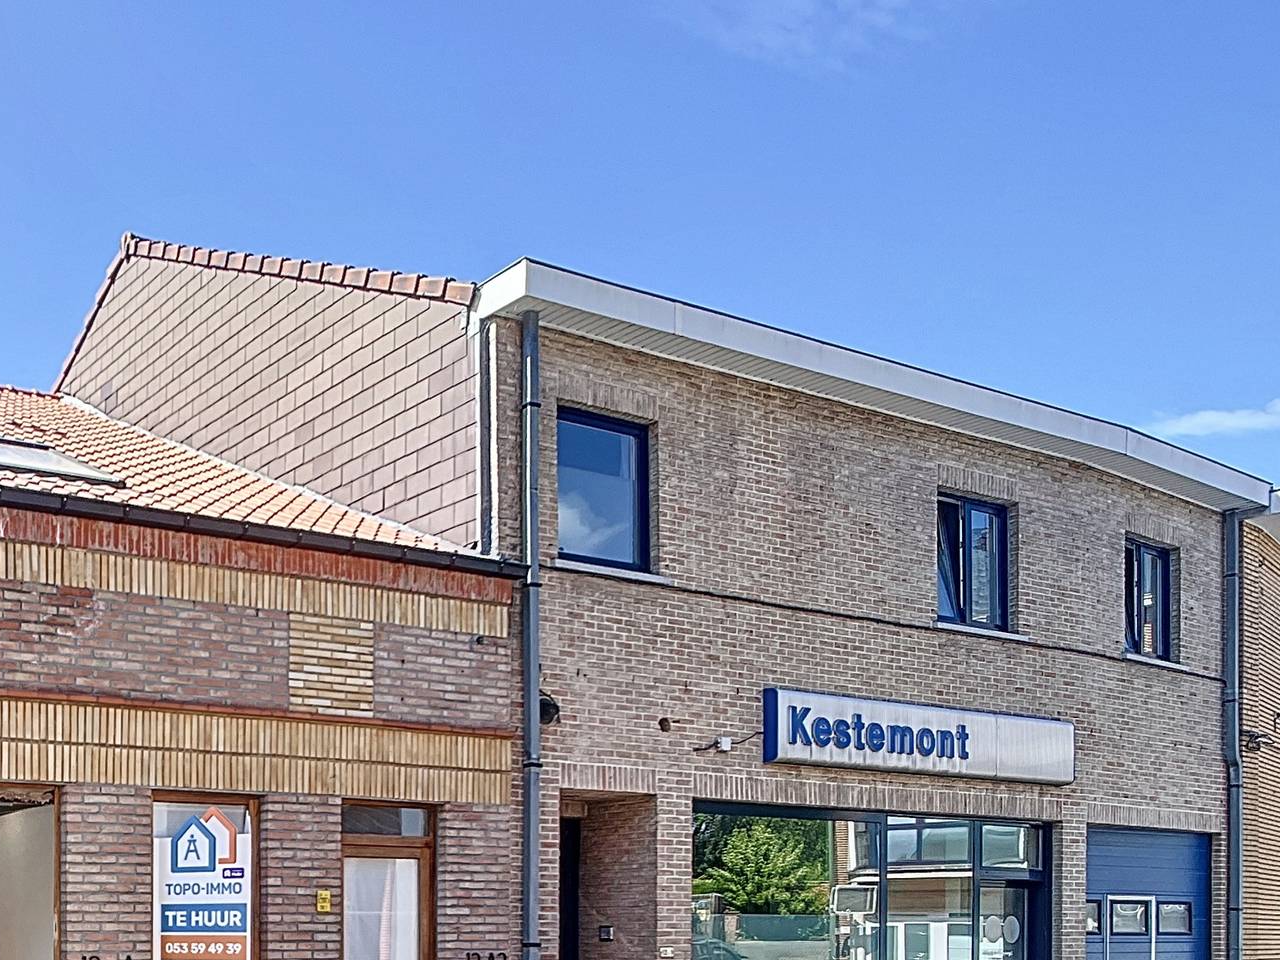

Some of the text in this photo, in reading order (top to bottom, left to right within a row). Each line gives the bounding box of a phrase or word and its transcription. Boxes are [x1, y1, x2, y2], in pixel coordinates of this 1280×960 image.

[787, 704, 970, 760] Kestemont
[165, 882, 243, 895] TOPO-IMMO
[165, 910, 242, 927] TE HUUR
[165, 943, 242, 954] 053 59 49 39
